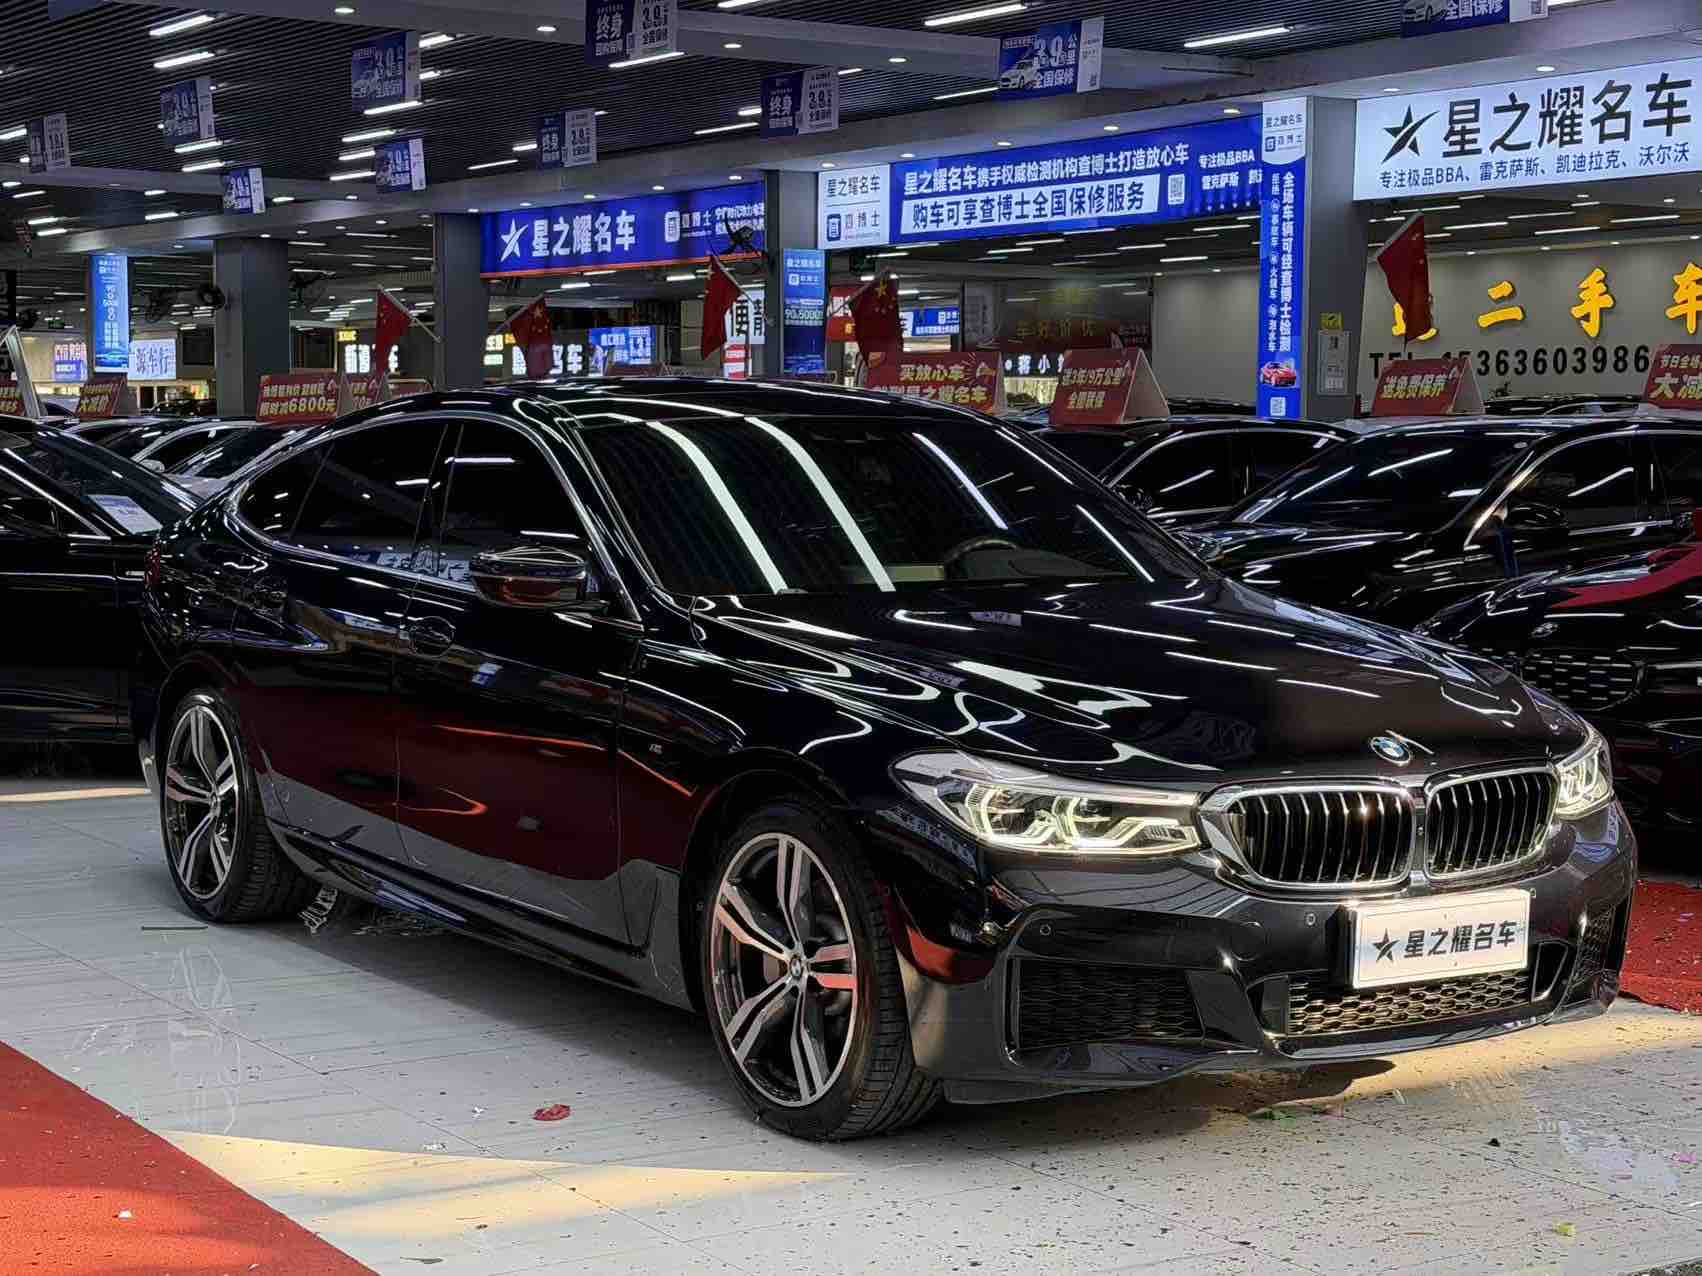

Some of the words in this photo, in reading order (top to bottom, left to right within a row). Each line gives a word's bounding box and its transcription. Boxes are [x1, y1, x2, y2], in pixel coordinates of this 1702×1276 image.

[1033, 67, 1074, 89] 全国保修
[1442, 73, 1692, 158] 星之耀名车
[826, 174, 880, 197] 星之耀名车
[912, 181, 1145, 230] 购车可享查博士全国保修服务
[532, 210, 636, 257] 星之耀名车
[1392, 263, 1702, 341] 二手车
[900, 363, 965, 382] 买放心车
[1404, 920, 1518, 958] 星之耀名车
